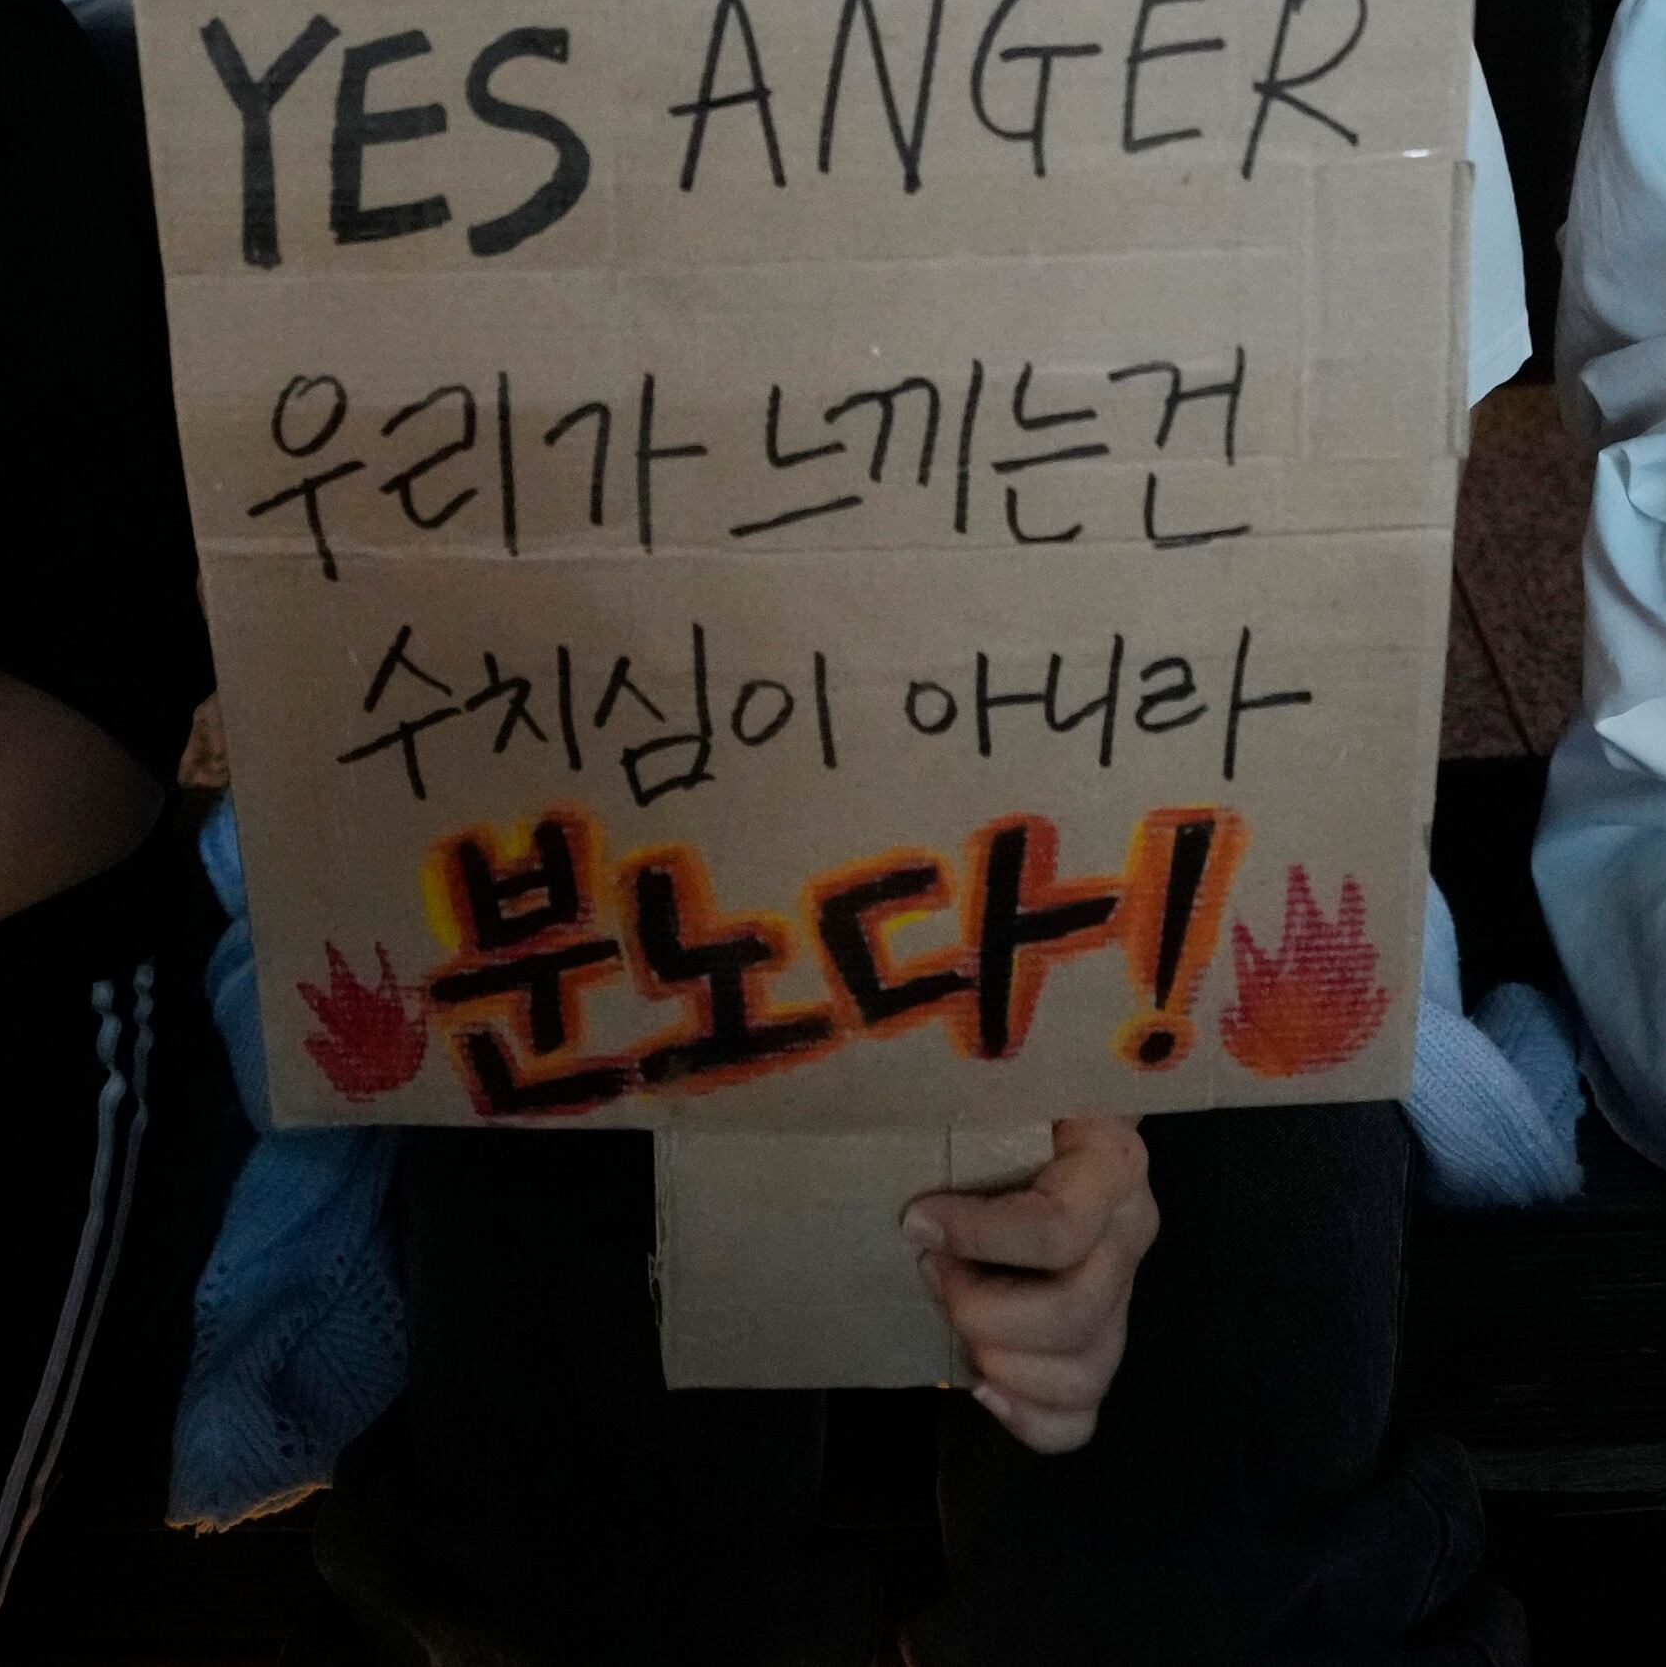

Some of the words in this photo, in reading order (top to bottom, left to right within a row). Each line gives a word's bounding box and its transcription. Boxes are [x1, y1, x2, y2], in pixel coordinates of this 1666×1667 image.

[197, 11, 593, 269] YES
[248, 369, 707, 582] 우리가
[335, 623, 836, 807] 수치심이
[904, 625, 1312, 779] 아니라
[425, 810, 1233, 1116] 분노다!
